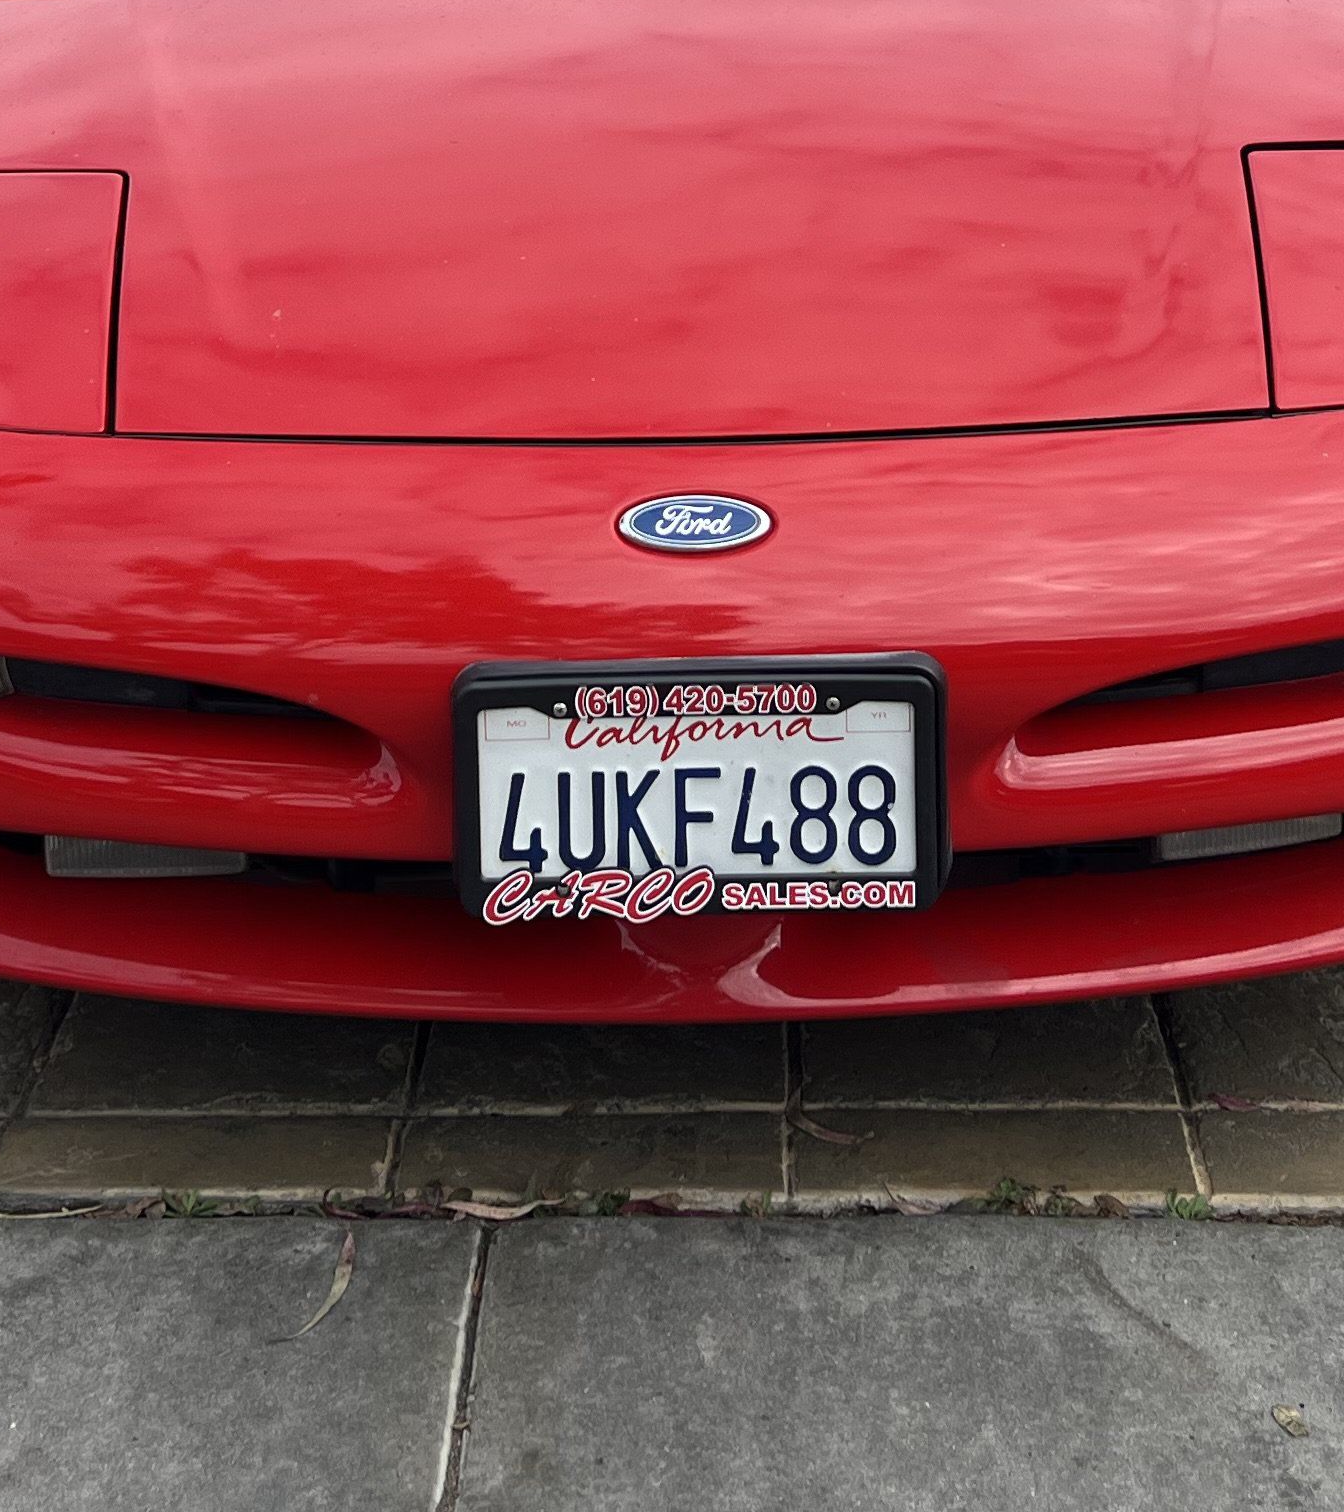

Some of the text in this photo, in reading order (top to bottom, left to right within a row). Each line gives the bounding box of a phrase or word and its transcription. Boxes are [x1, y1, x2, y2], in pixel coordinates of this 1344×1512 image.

[655, 504, 733, 536] Ford
[574, 683, 817, 719] (619) 420-5700
[564, 714, 845, 762] California
[499, 764, 898, 873] 4UKF488
[483, 867, 915, 925] CARCO SALES.COM
